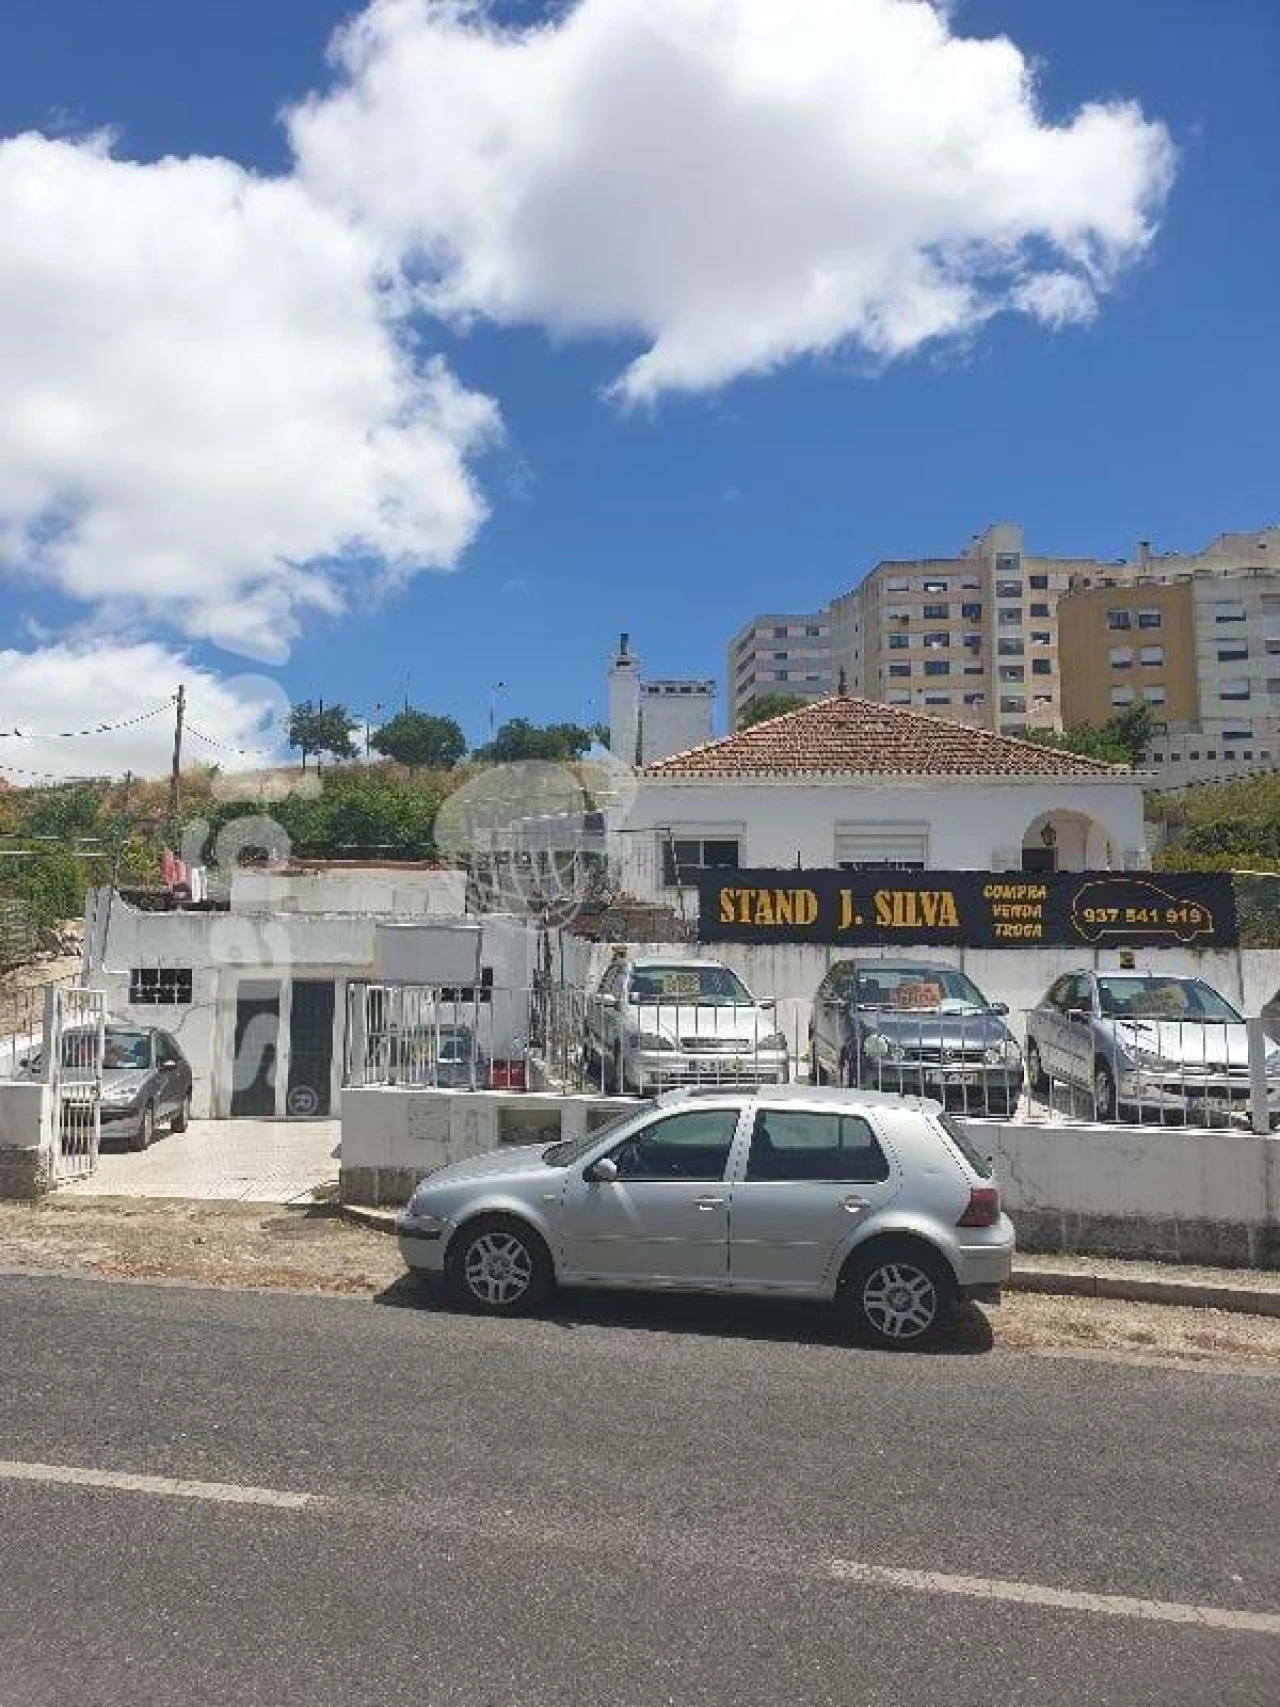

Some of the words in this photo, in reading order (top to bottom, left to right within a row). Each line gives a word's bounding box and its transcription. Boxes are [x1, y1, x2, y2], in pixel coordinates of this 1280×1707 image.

[983, 885, 1047, 900] COMPRA
[720, 888, 818, 925] STAND
[838, 889, 863, 930] J.
[874, 889, 959, 927] SILVA
[992, 904, 1042, 919] VENDA
[1083, 908, 1118, 923] 937
[1125, 908, 1157, 923] 541
[1166, 908, 1201, 923] 919
